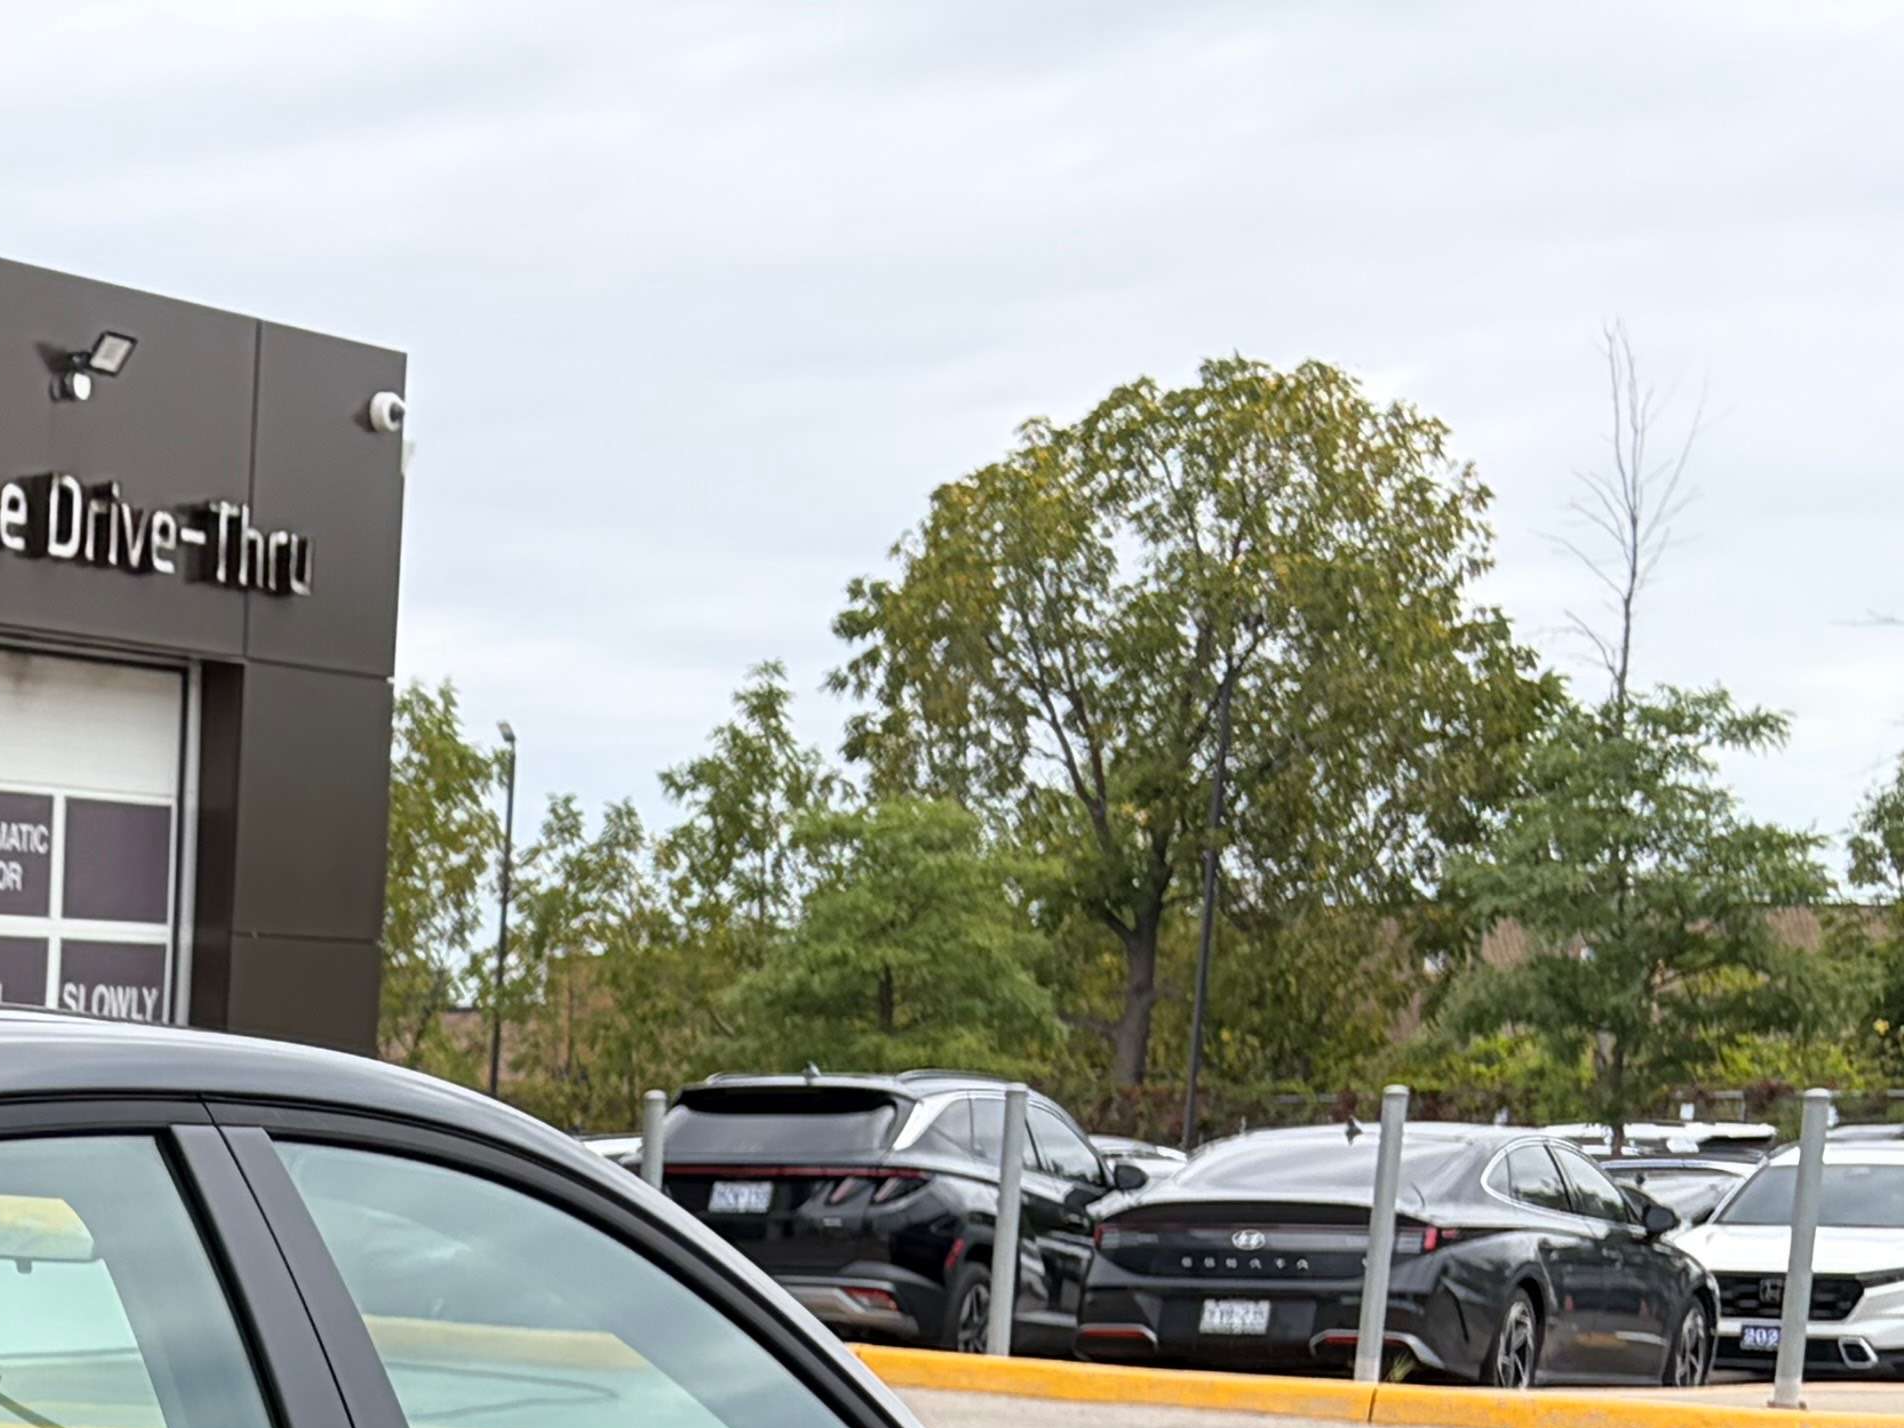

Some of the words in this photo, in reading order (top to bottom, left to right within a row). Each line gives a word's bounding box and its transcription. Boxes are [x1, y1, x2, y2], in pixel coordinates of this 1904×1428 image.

[49, 473, 315, 596] Drive-Thru
[63, 981, 160, 1021] SLOWLY
[1743, 1326, 1780, 1346] 202
